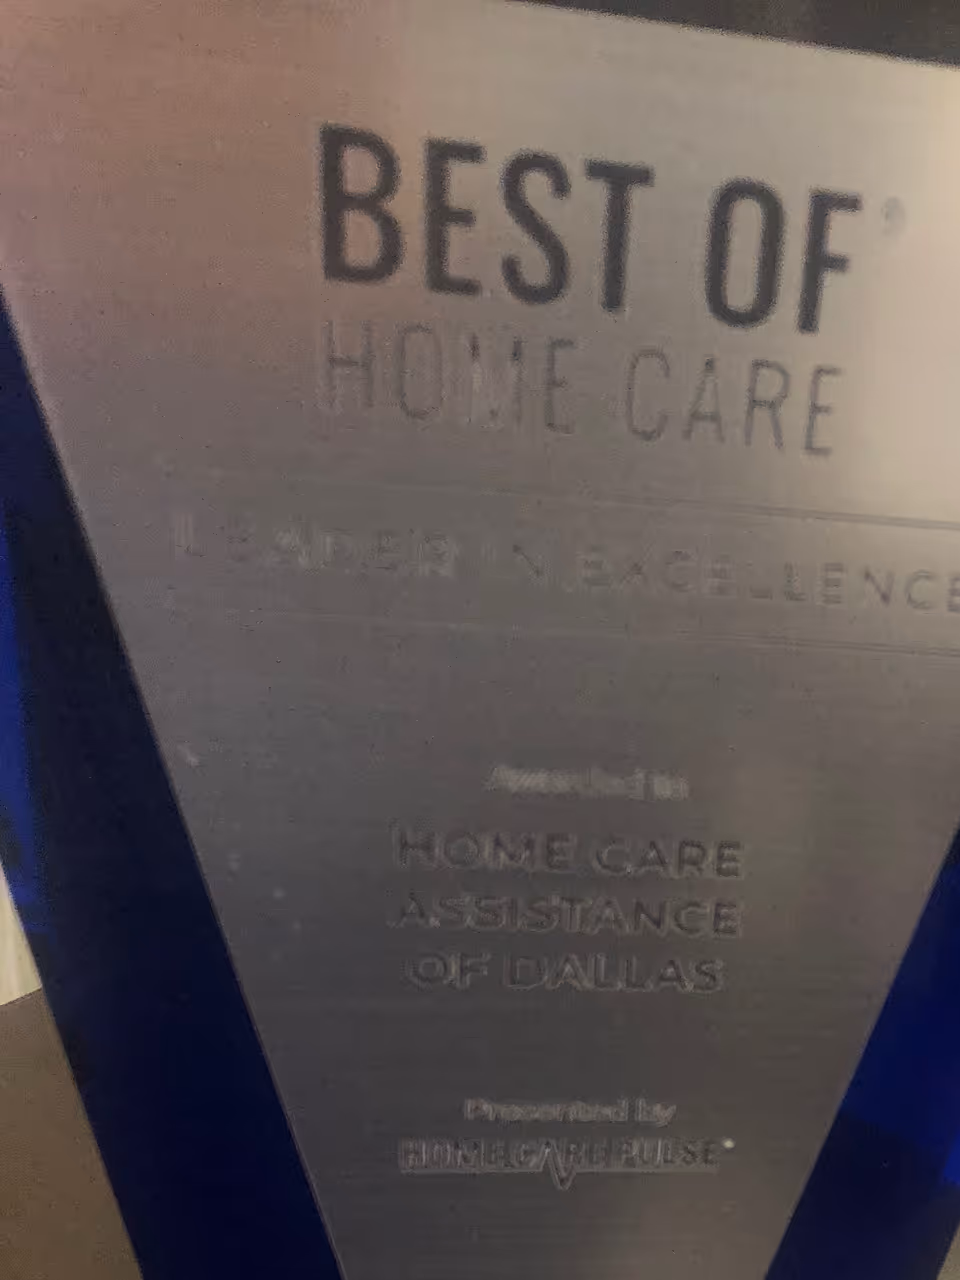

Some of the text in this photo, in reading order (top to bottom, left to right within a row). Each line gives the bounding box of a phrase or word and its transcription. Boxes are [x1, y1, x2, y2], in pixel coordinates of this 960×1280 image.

[318, 122, 862, 336] BEST OF
[625, 347, 842, 457] CARE
[394, 828, 744, 879] HOME CARE
[389, 894, 741, 938] ASSISTANCE
[403, 951, 725, 992] OF DALLAS
